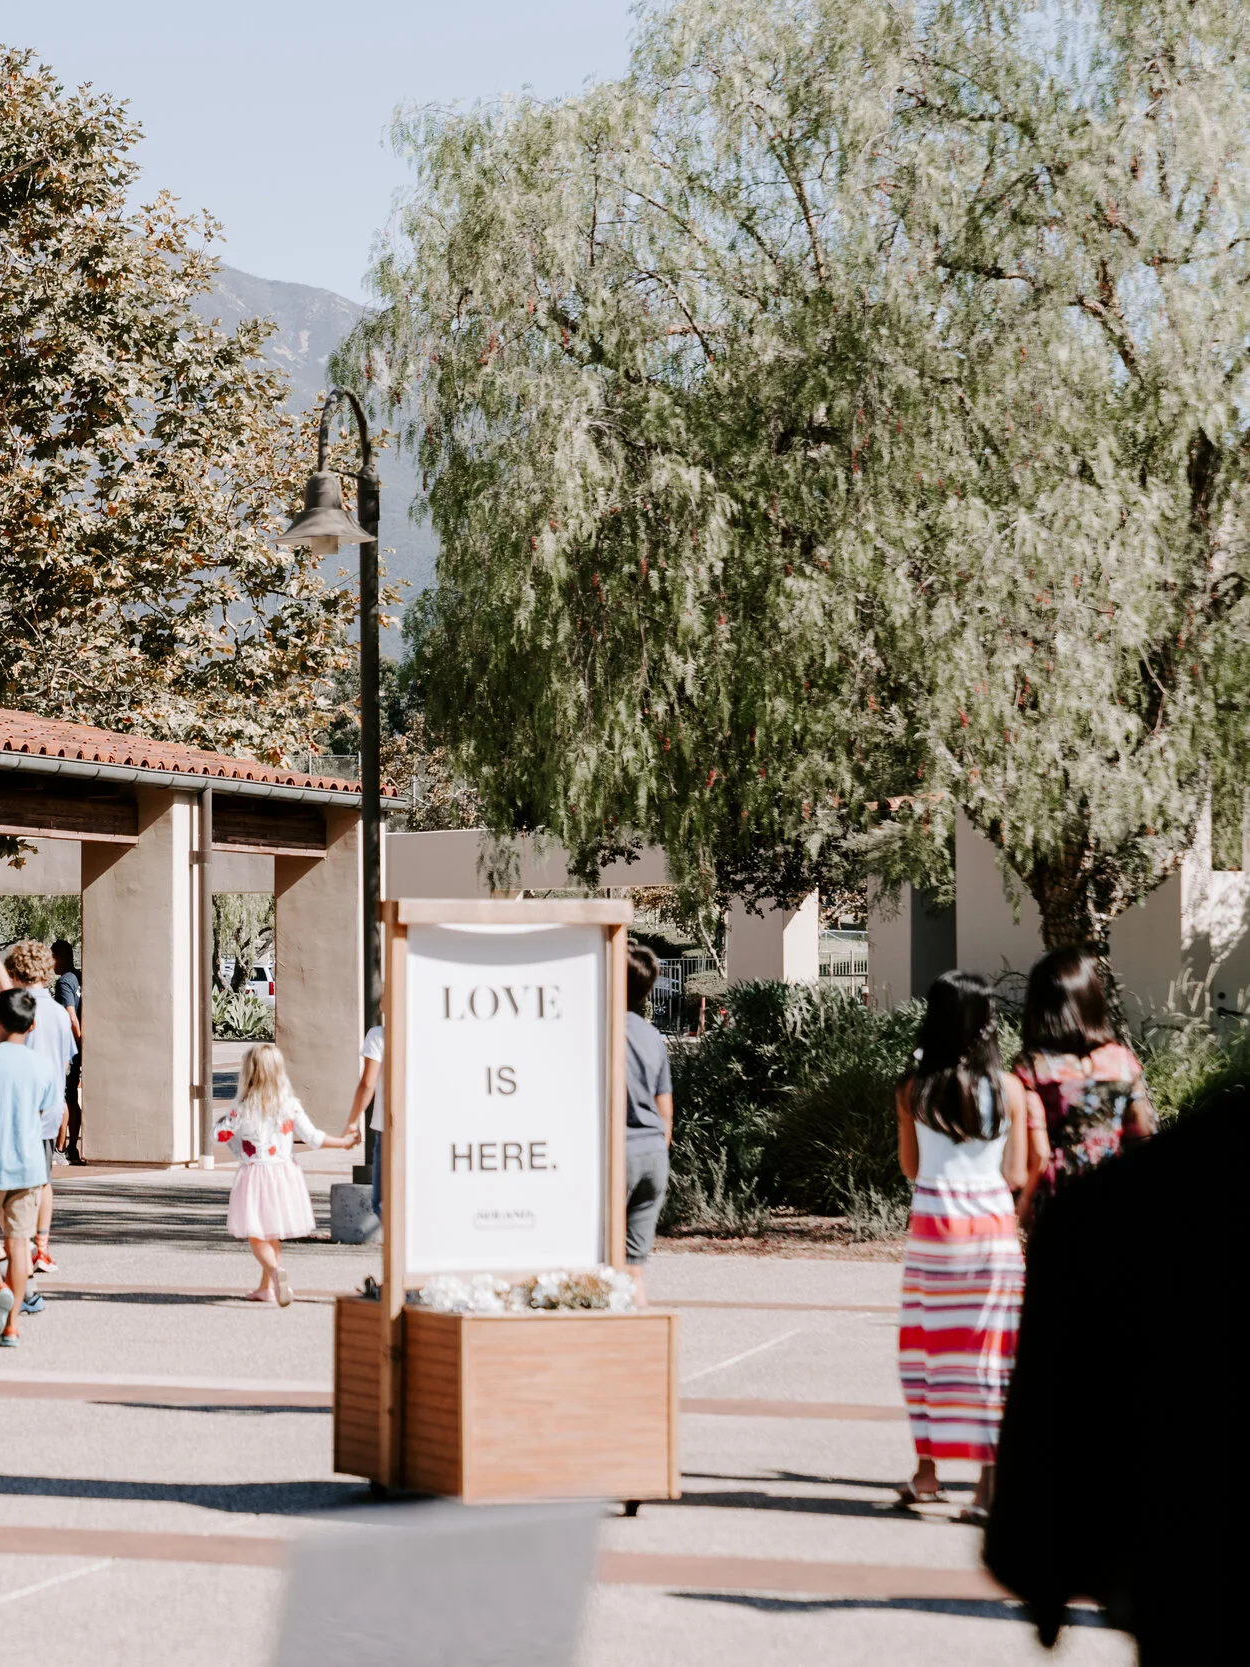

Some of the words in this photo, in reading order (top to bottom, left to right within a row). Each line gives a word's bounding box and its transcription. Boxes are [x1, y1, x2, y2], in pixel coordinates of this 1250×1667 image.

[444, 986, 560, 1019] LOVE
[487, 1066, 517, 1095] IS
[451, 1142, 556, 1172] HERE.
